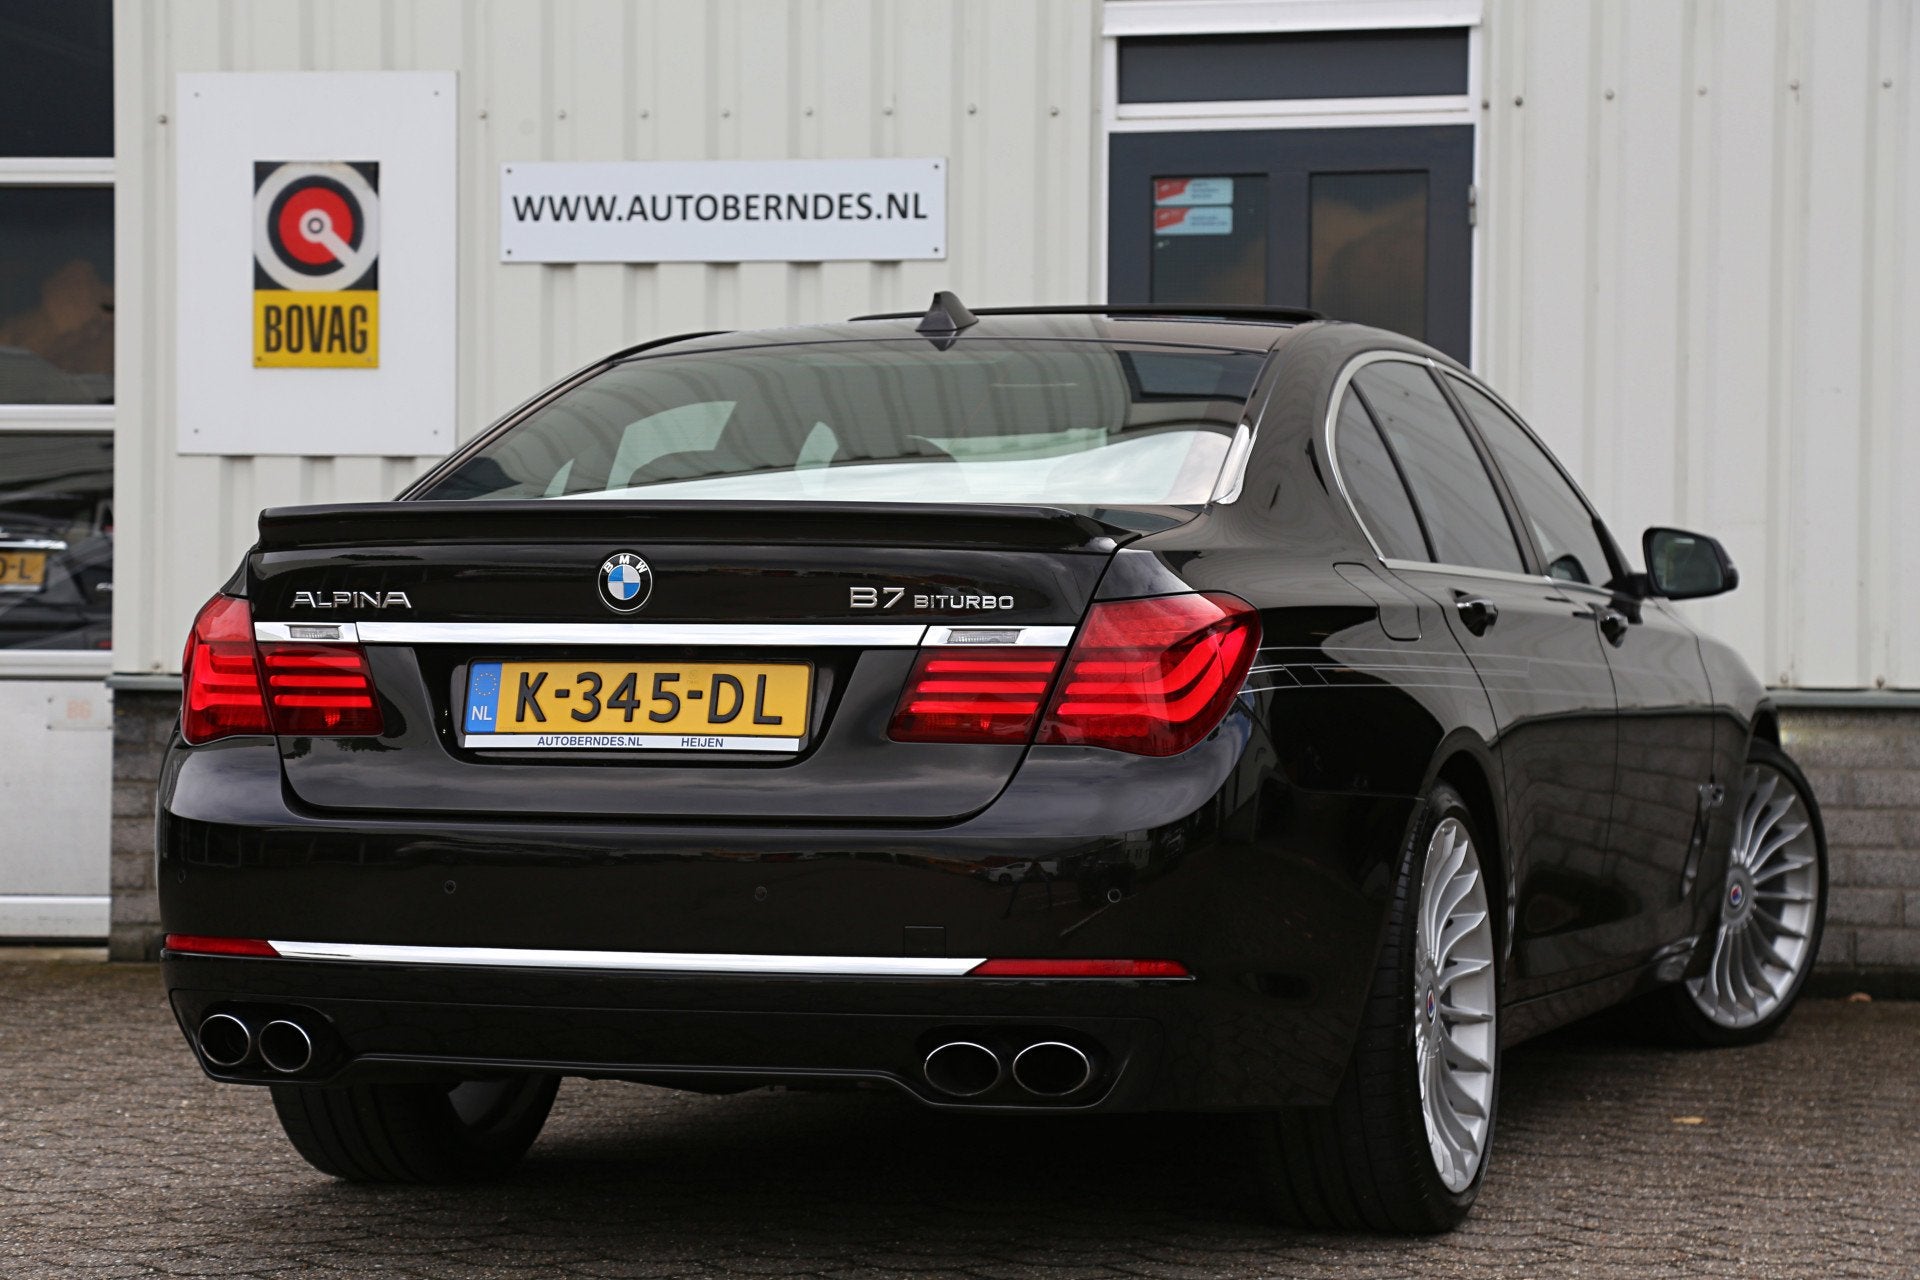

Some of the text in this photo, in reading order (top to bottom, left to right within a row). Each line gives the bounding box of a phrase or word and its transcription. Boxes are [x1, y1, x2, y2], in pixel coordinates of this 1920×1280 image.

[512, 192, 928, 222] WWW.AUTOBERNDES.NL
[264, 304, 368, 354] BOVAG
[603, 554, 648, 574] BMW
[290, 591, 412, 608] ALPINA
[850, 586, 1015, 610] B7 BITURBO
[515, 671, 783, 726] K-345-DL
[471, 705, 493, 722] NL
[537, 735, 724, 748] AUTOBERNDES.NL HEIJEN
